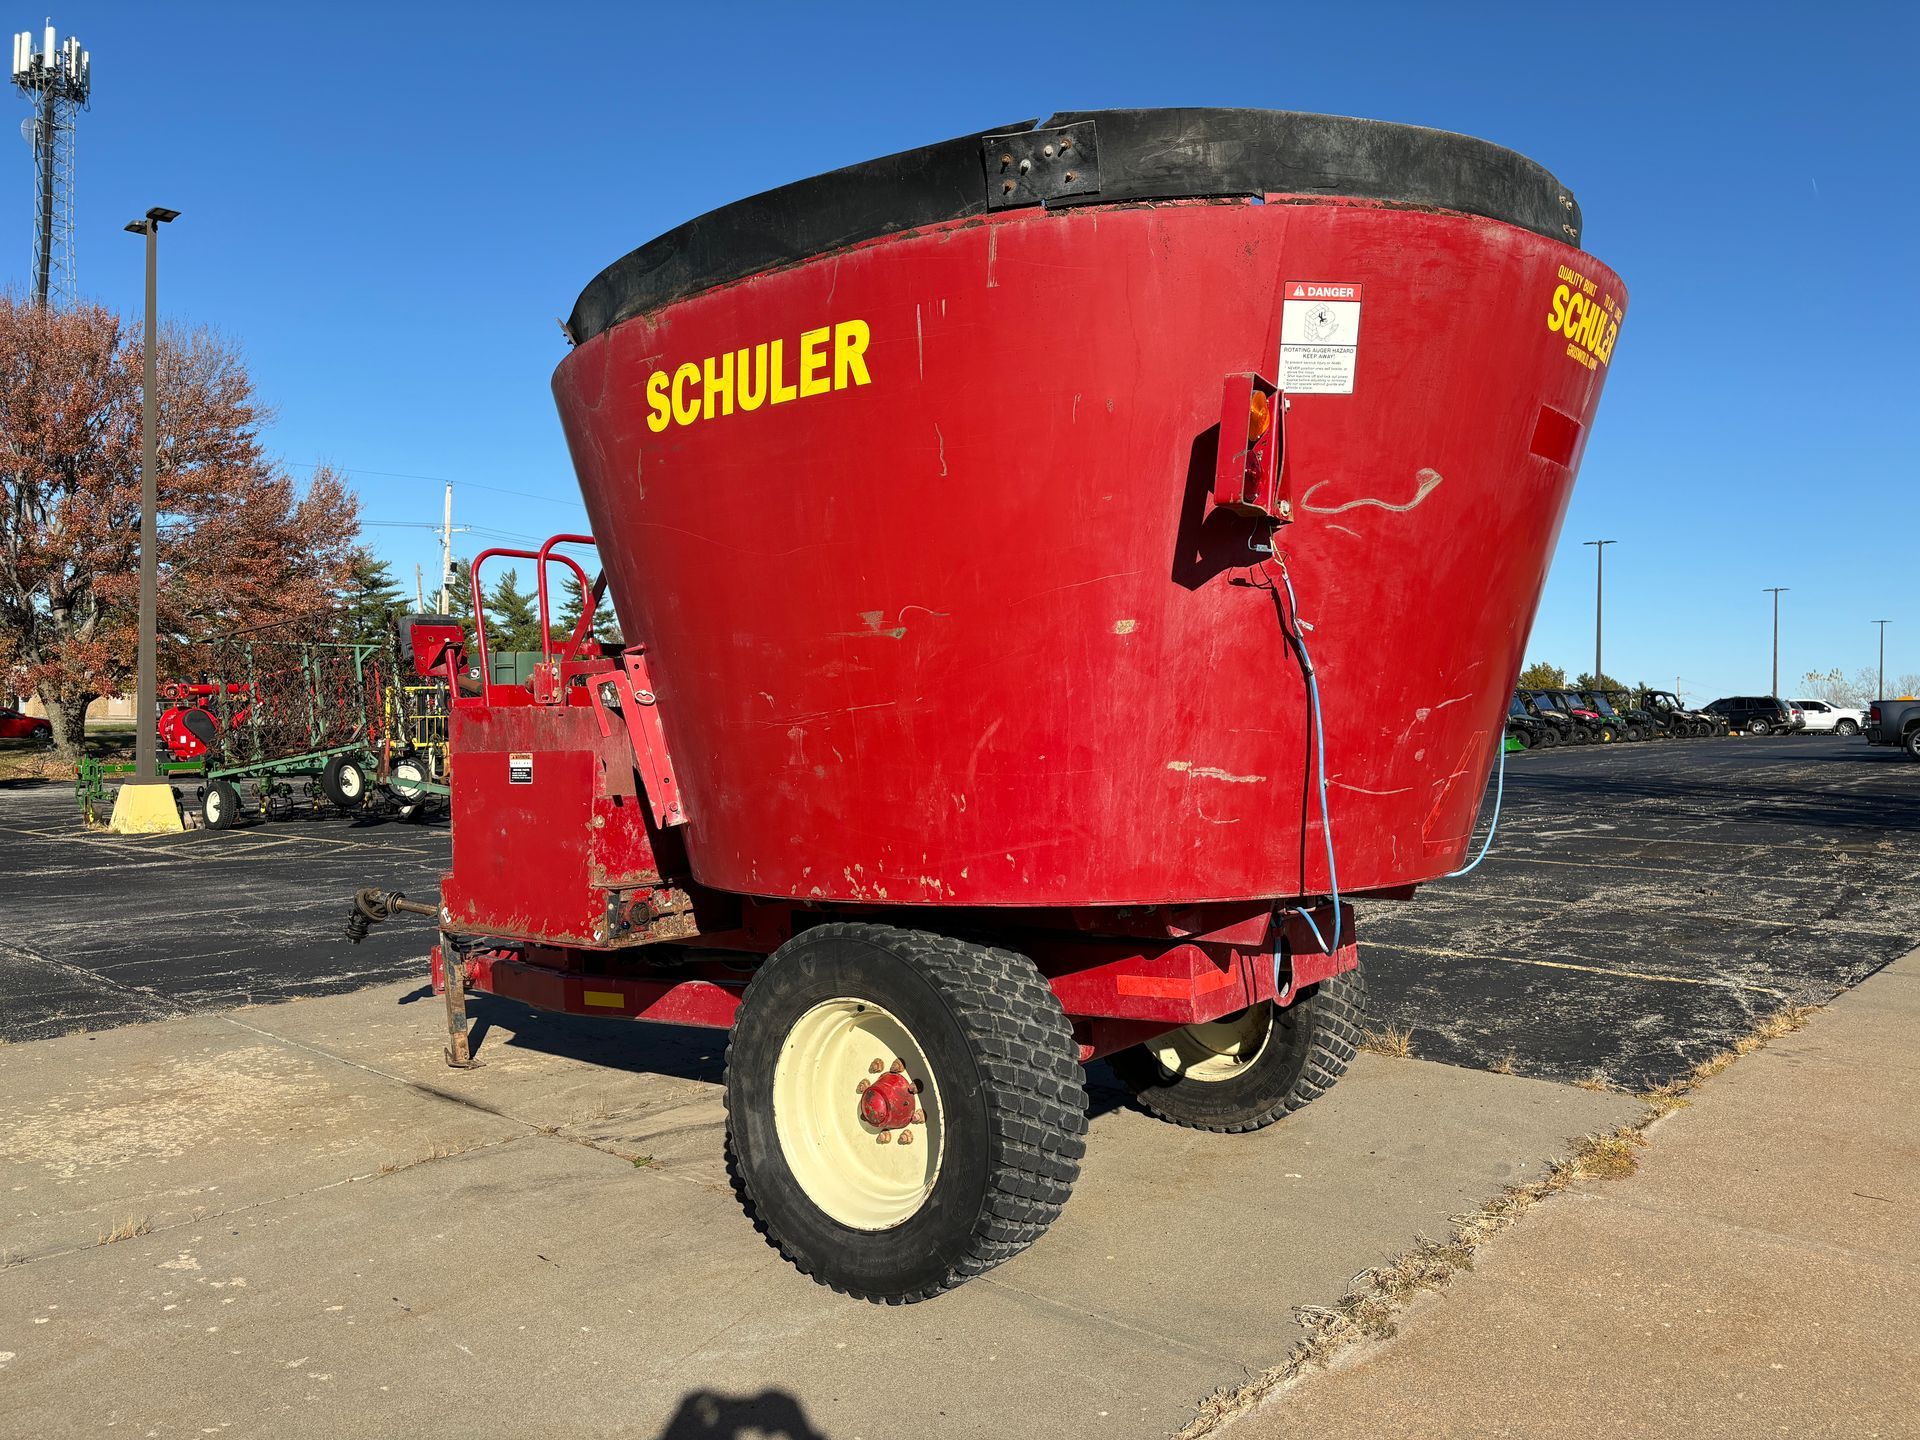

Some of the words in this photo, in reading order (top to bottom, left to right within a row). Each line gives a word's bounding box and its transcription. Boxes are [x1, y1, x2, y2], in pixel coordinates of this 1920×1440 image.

[1308, 287, 1354, 298] DANGER
[1558, 264, 1584, 288] QUALITY
[1548, 284, 1618, 367] SCHULER
[646, 320, 872, 432] SCHULER
